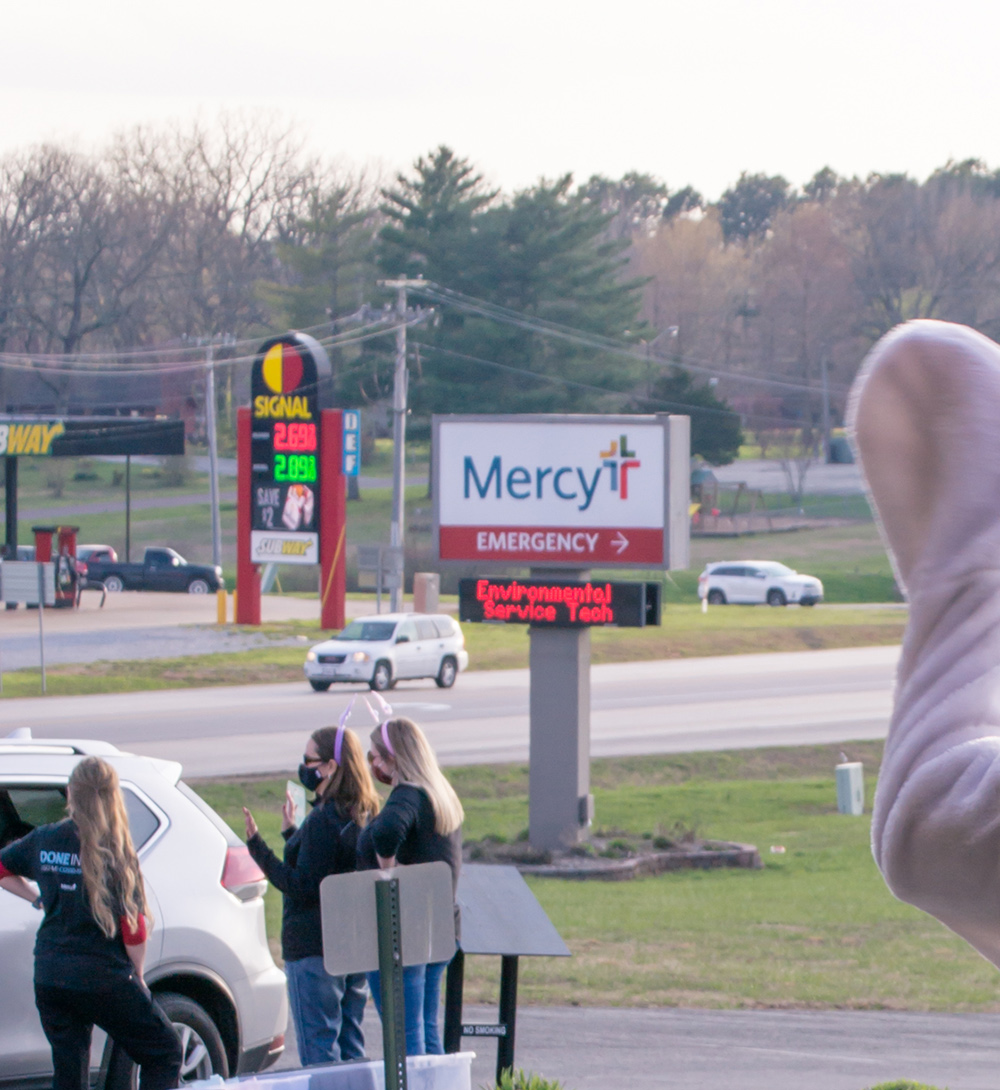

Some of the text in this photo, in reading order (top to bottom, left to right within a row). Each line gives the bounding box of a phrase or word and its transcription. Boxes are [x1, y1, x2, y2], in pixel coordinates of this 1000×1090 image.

[254, 395, 312, 419] SIGNAL
[464, 456, 602, 511] Mercy
[257, 488, 280, 506] SAVE
[257, 538, 313, 556] SUBWAY
[477, 531, 599, 552] EMERGENCY
[477, 580, 612, 604] Environmental
[484, 601, 613, 622] Service Tech
[40, 851, 70, 865] DONE
[463, 1026, 506, 1035] NO SMOKING
